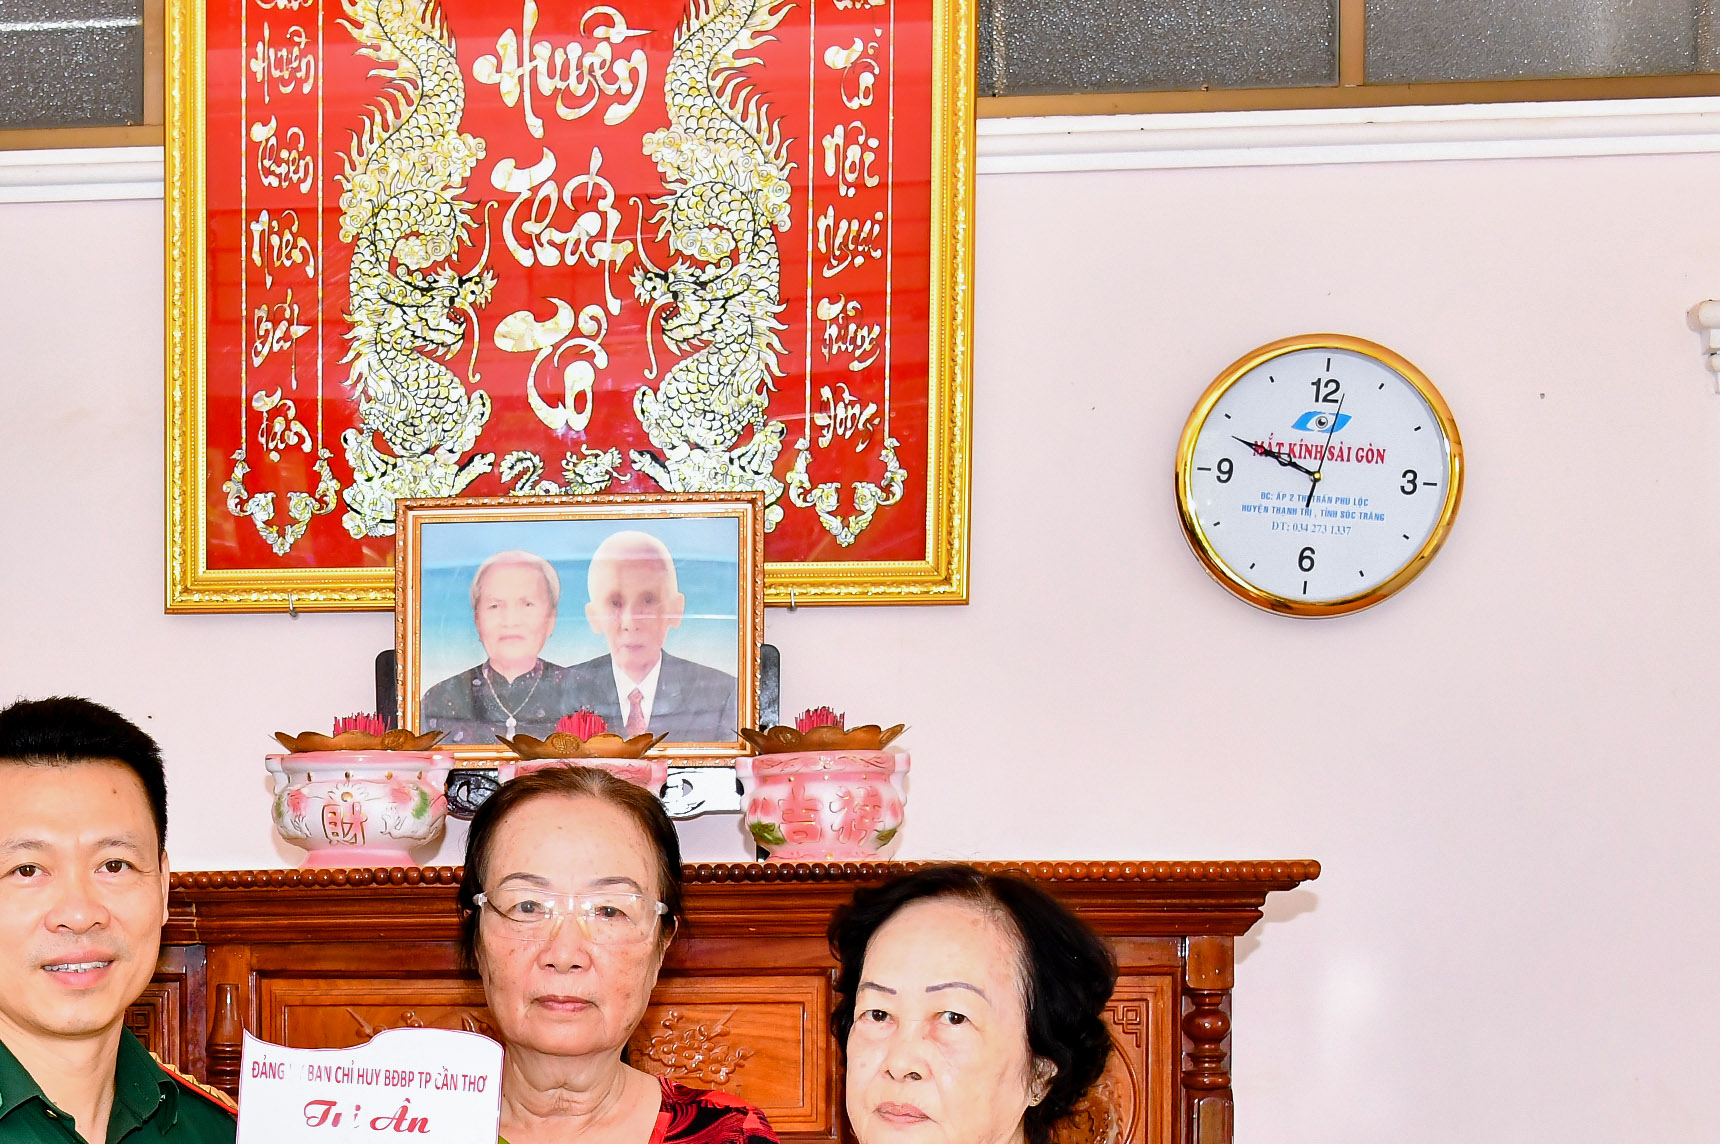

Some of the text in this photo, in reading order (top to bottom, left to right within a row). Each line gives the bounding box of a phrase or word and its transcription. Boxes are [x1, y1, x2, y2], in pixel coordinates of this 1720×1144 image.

[490, 146, 634, 316] Thất
[493, 296, 609, 432] Tổ
[1311, 378, 1341, 404] 12
[1288, 438, 1323, 461] KÍNH
[1355, 443, 1386, 464] GÒN
[1216, 458, 1234, 483] 9
[1400, 469, 1418, 495] 3
[1298, 546, 1316, 572] 6
[251, 1054, 285, 1080] ĐẢNG
[307, 1064, 332, 1082] BAN
[335, 1060, 354, 1084] CHỈ
[357, 1068, 381, 1086] HUY
[384, 1069, 414, 1088] BĐBP
[418, 1071, 432, 1089] TP
[435, 1065, 458, 1091] CẦN
[462, 1074, 487, 1093] THƠ
[370, 1097, 430, 1134] Ân
